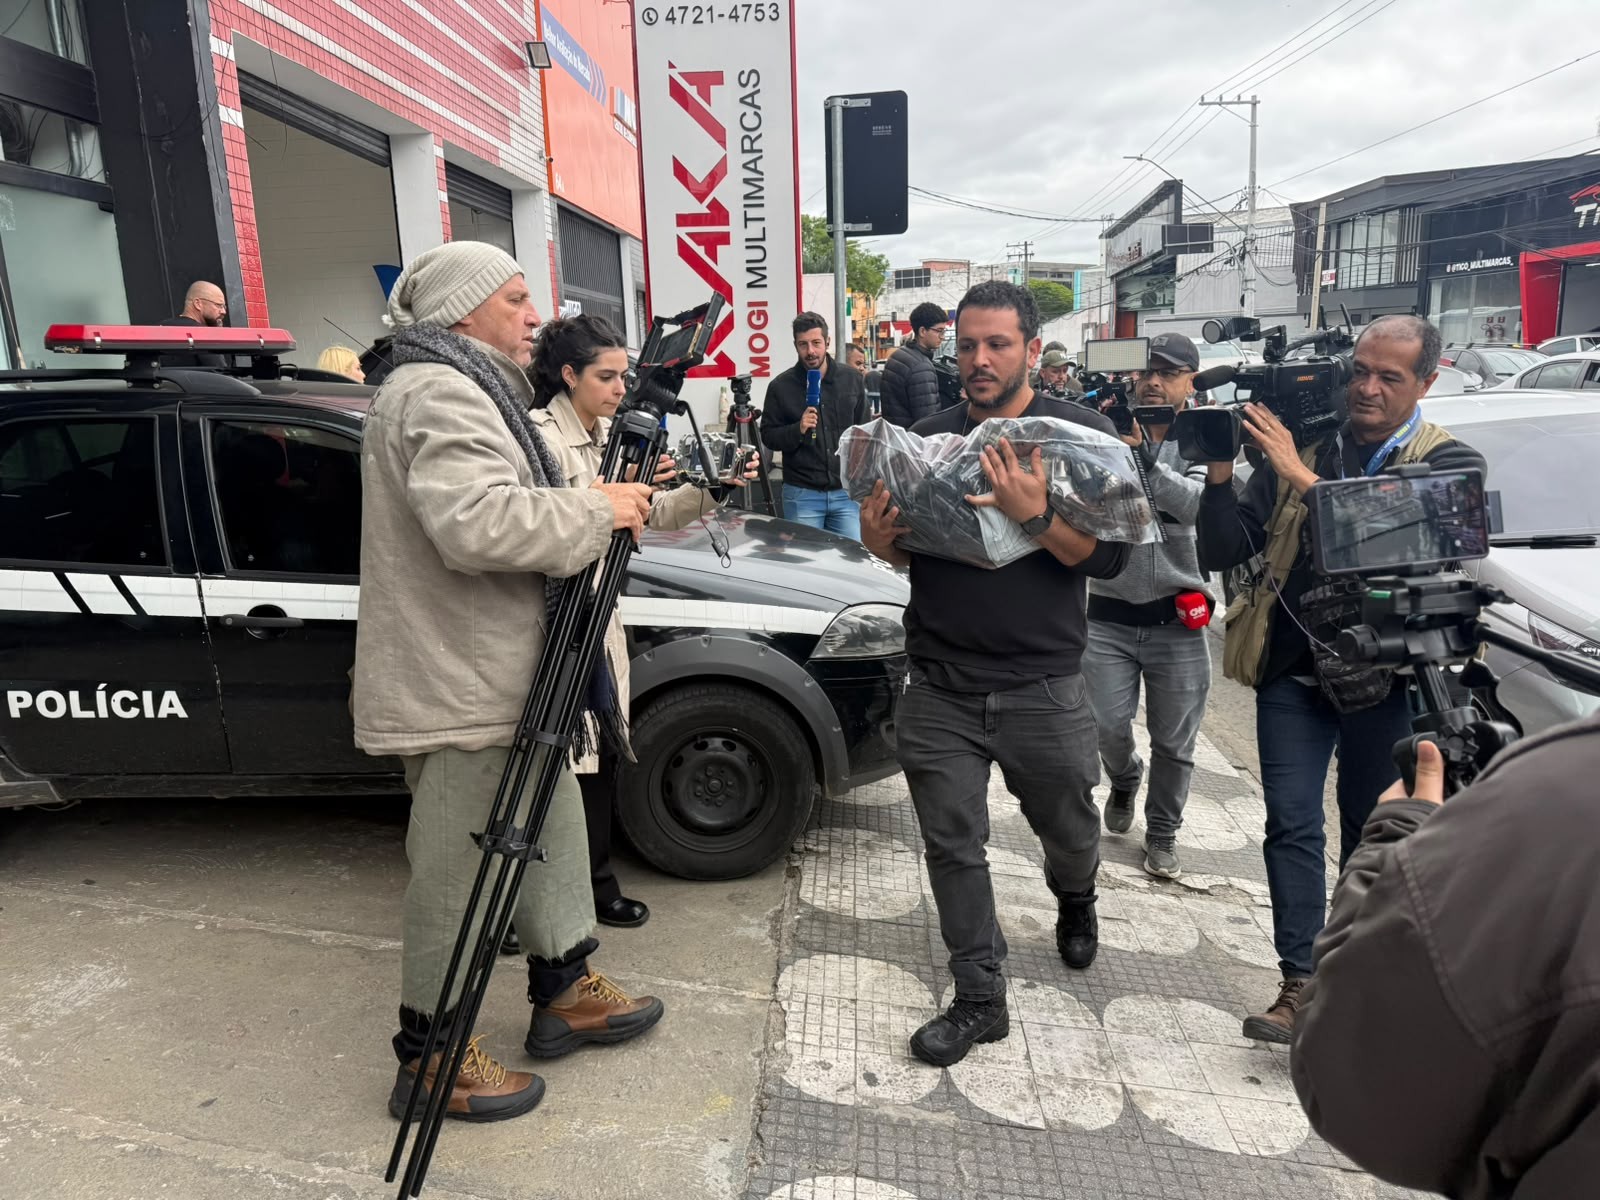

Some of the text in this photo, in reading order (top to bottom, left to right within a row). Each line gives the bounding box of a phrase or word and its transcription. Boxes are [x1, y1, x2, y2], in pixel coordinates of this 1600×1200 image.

[665, 3, 780, 25] 4721-4753
[737, 68, 771, 378] MOGI MULTIMARCAS
[6, 682, 189, 719] POLÍCIA
